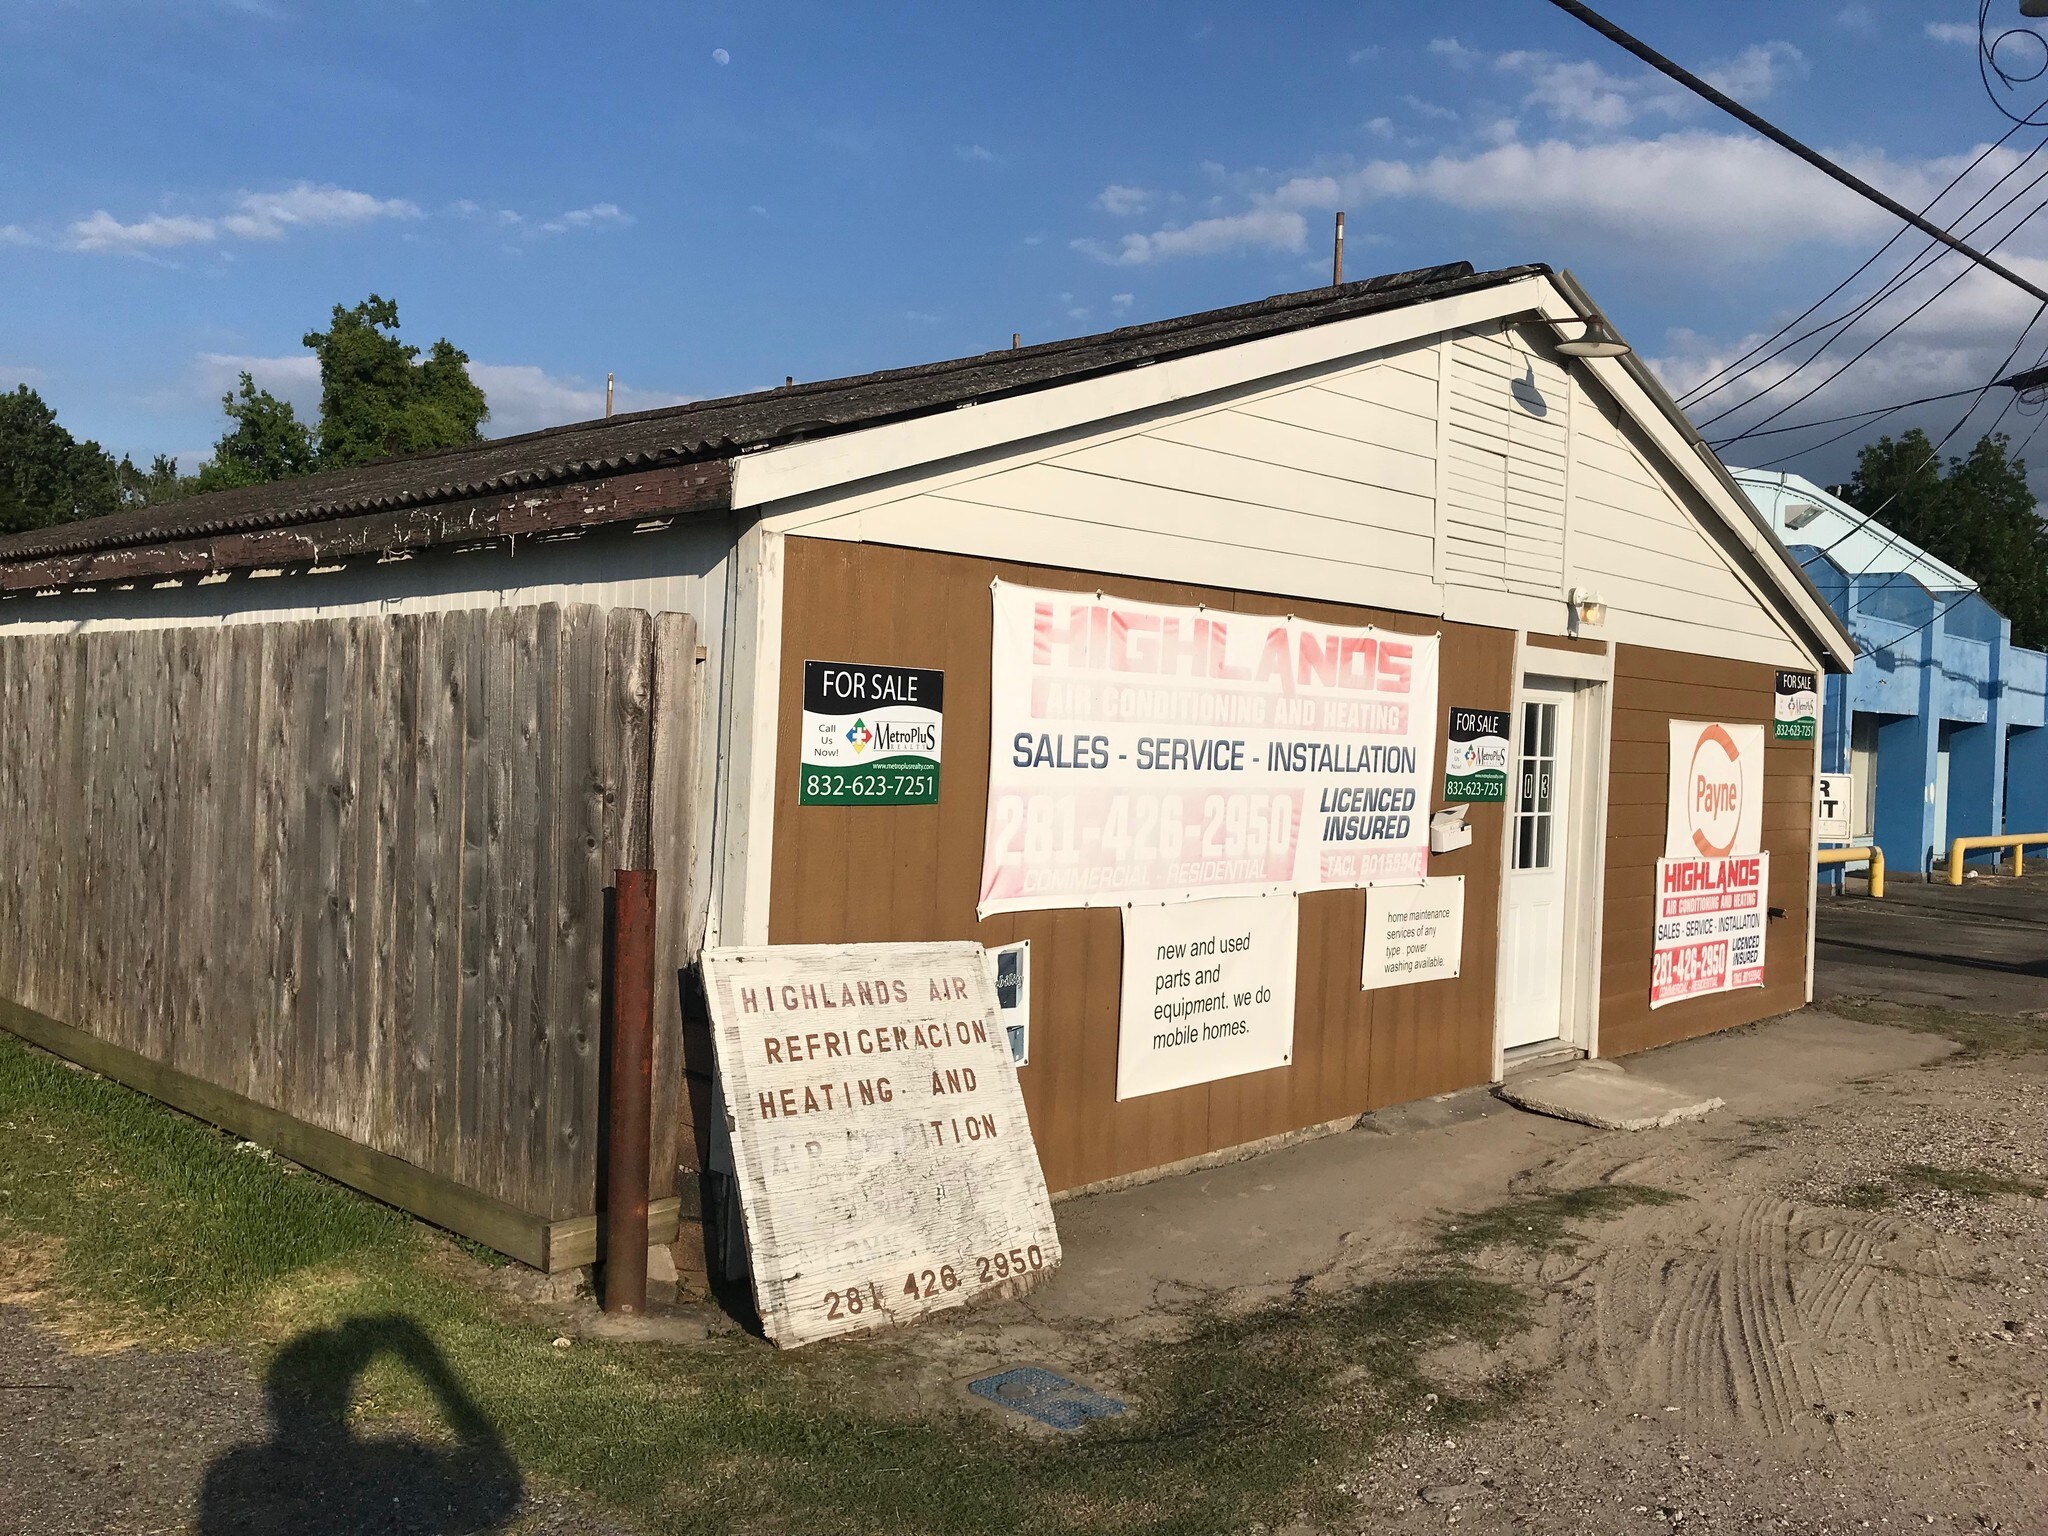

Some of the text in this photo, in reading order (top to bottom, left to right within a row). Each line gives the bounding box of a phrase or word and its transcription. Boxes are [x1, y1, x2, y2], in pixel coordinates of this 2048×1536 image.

[1033, 602, 1412, 695] HIGHLANDS
[823, 670, 918, 701] FOR SALE
[1783, 674, 1811, 690] FOR SALE
[1047, 686, 1400, 731] AIR CONDITIONING AND HEATING
[818, 724, 836, 733] Call
[1456, 713, 1499, 733] FOR SALE
[1776, 724, 1814, 737] 832-623-7251
[814, 748, 839, 757] Now!
[821, 737, 833, 745] Us
[1013, 732, 1109, 769] SALES
[1136, 737, 1245, 771] SERVICE
[1268, 741, 1416, 773] INSTALLATION
[873, 763, 935, 771] www.metroplusrealty.com
[806, 775, 933, 796] 832-623-7251
[1447, 781, 1503, 796] 832-623-7251
[1697, 775, 1737, 820] Payne
[1321, 787, 1416, 812] LICENCED
[995, 794, 1293, 867] 281-426-2950
[1323, 815, 1410, 840] INSURED
[1024, 865, 1150, 891] COMMERCIAL
[1167, 858, 1267, 884] RESIDENTIAL
[1664, 859, 1760, 893] HIGHLANDS
[1388, 909, 1450, 923] home maintenance
[1658, 923, 1680, 941] SALES
[1686, 919, 1713, 937] SERVICE
[1718, 913, 1760, 932] INSTALLATION
[1386, 925, 1437, 940] services of any
[1732, 935, 1760, 951] LICENCED
[1157, 932, 1250, 960] new and used
[1386, 945, 1401, 959] type
[1406, 943, 1428, 956] power
[1732, 950, 1758, 965] INSURED
[1384, 960, 1413, 973] washing
[1414, 956, 1445, 969] available.
[1653, 943, 1725, 987] 281-426-2950
[1155, 963, 1221, 995] parts and
[741, 977, 968, 1013] HIGHLANDS AIR
[1154, 985, 1271, 1023] equipment. we do
[1153, 1020, 1249, 1050] mobile homes.
[758, 1067, 977, 1119] HEATING AND
[903, 1264, 957, 1301] 426
[976, 1244, 1043, 1283] 2950
